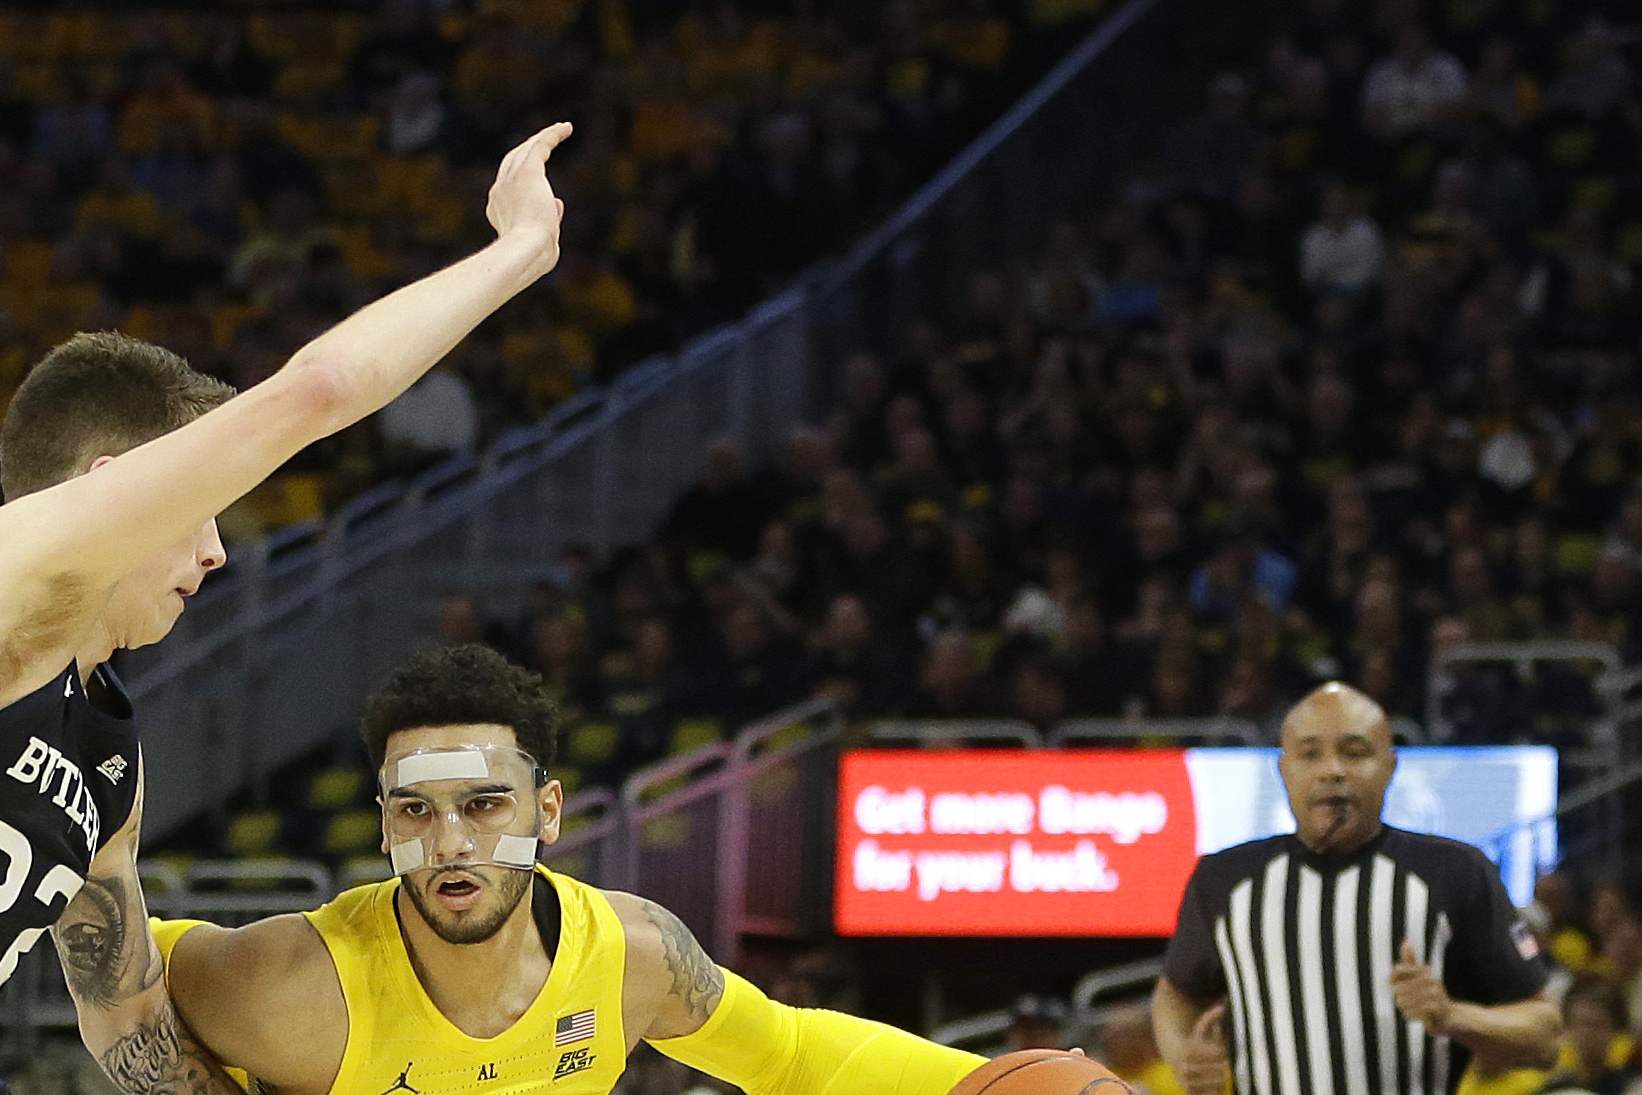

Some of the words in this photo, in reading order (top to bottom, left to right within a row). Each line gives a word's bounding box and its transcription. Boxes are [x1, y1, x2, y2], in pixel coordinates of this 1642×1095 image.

[855, 786, 925, 834] Get
[930, 792, 1035, 834] more
[853, 838, 913, 892] for
[915, 851, 1007, 901] your
[555, 1055, 597, 1074] EAST
[560, 1047, 590, 1063] BIG
[477, 1063, 498, 1081] AL
